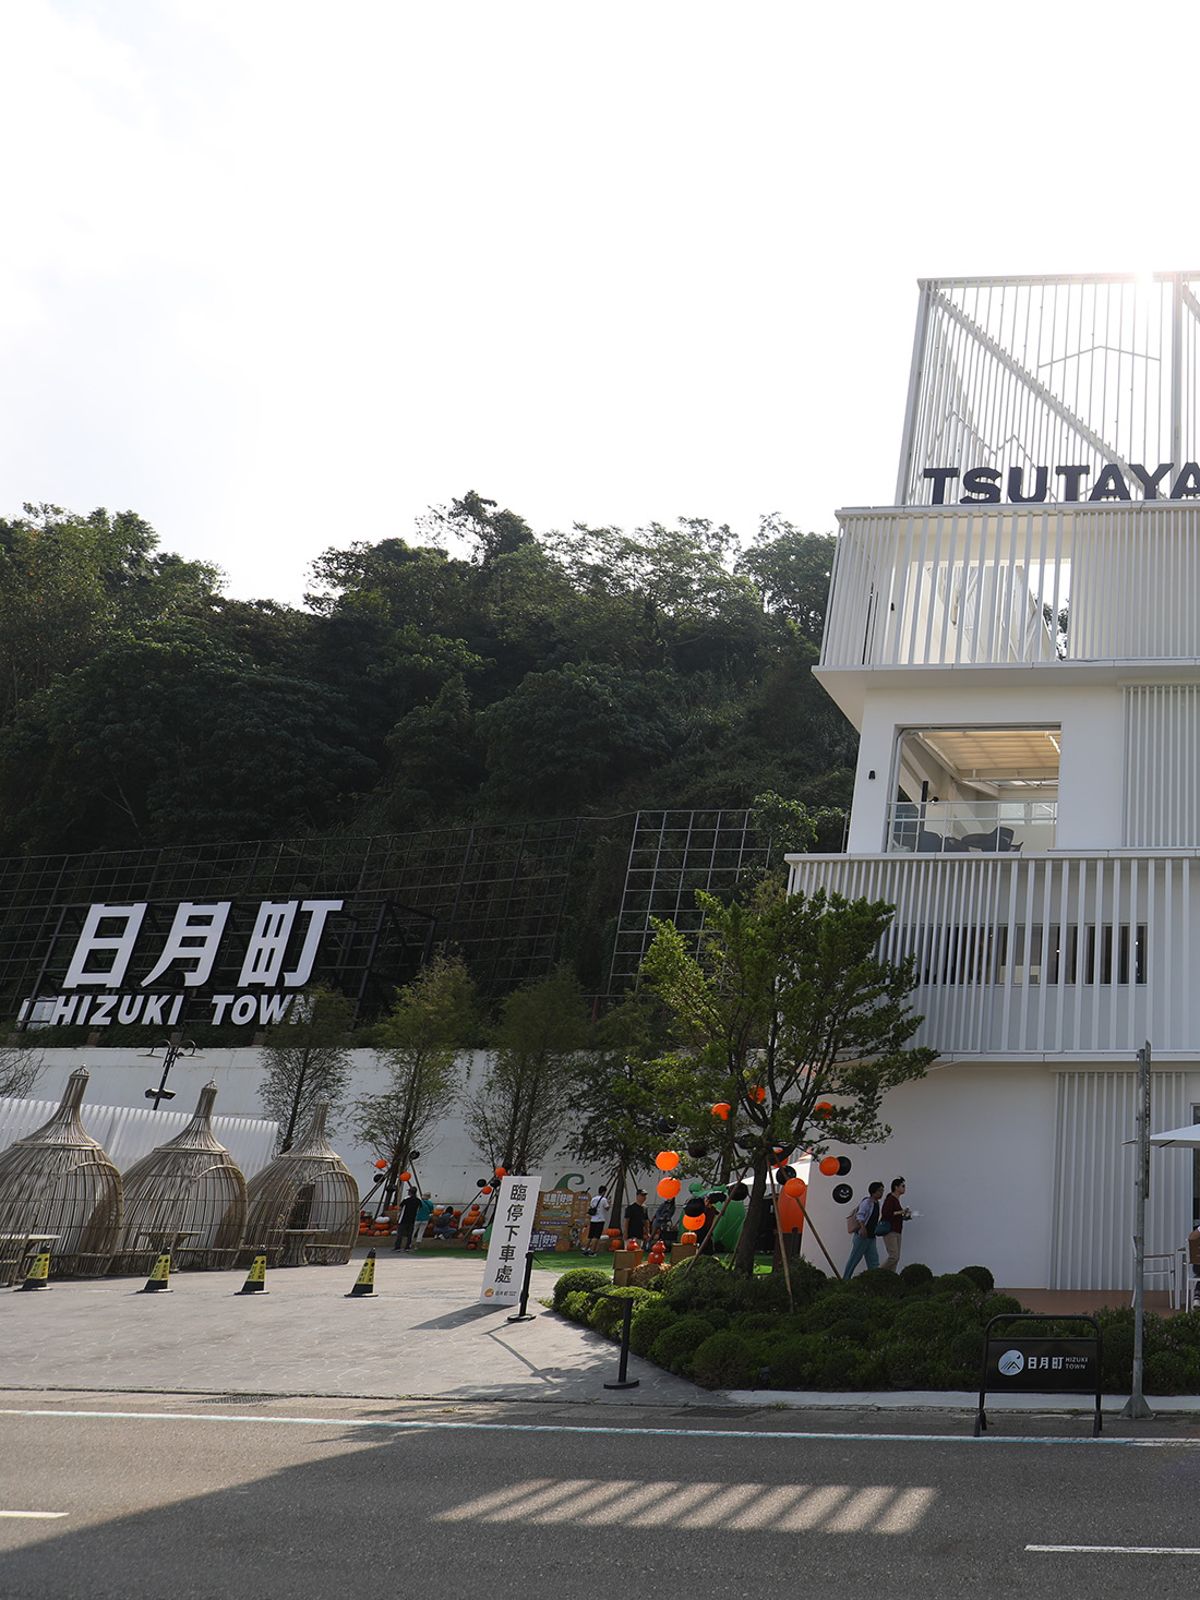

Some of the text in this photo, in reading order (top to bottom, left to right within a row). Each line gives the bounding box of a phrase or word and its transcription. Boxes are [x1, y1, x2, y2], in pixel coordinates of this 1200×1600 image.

[62, 900, 344, 989] 日月町
[50, 994, 185, 1026] HIZUKI
[495, 1184, 528, 1284] 臨停下車處
[1028, 1356, 1064, 1370] 日月町
